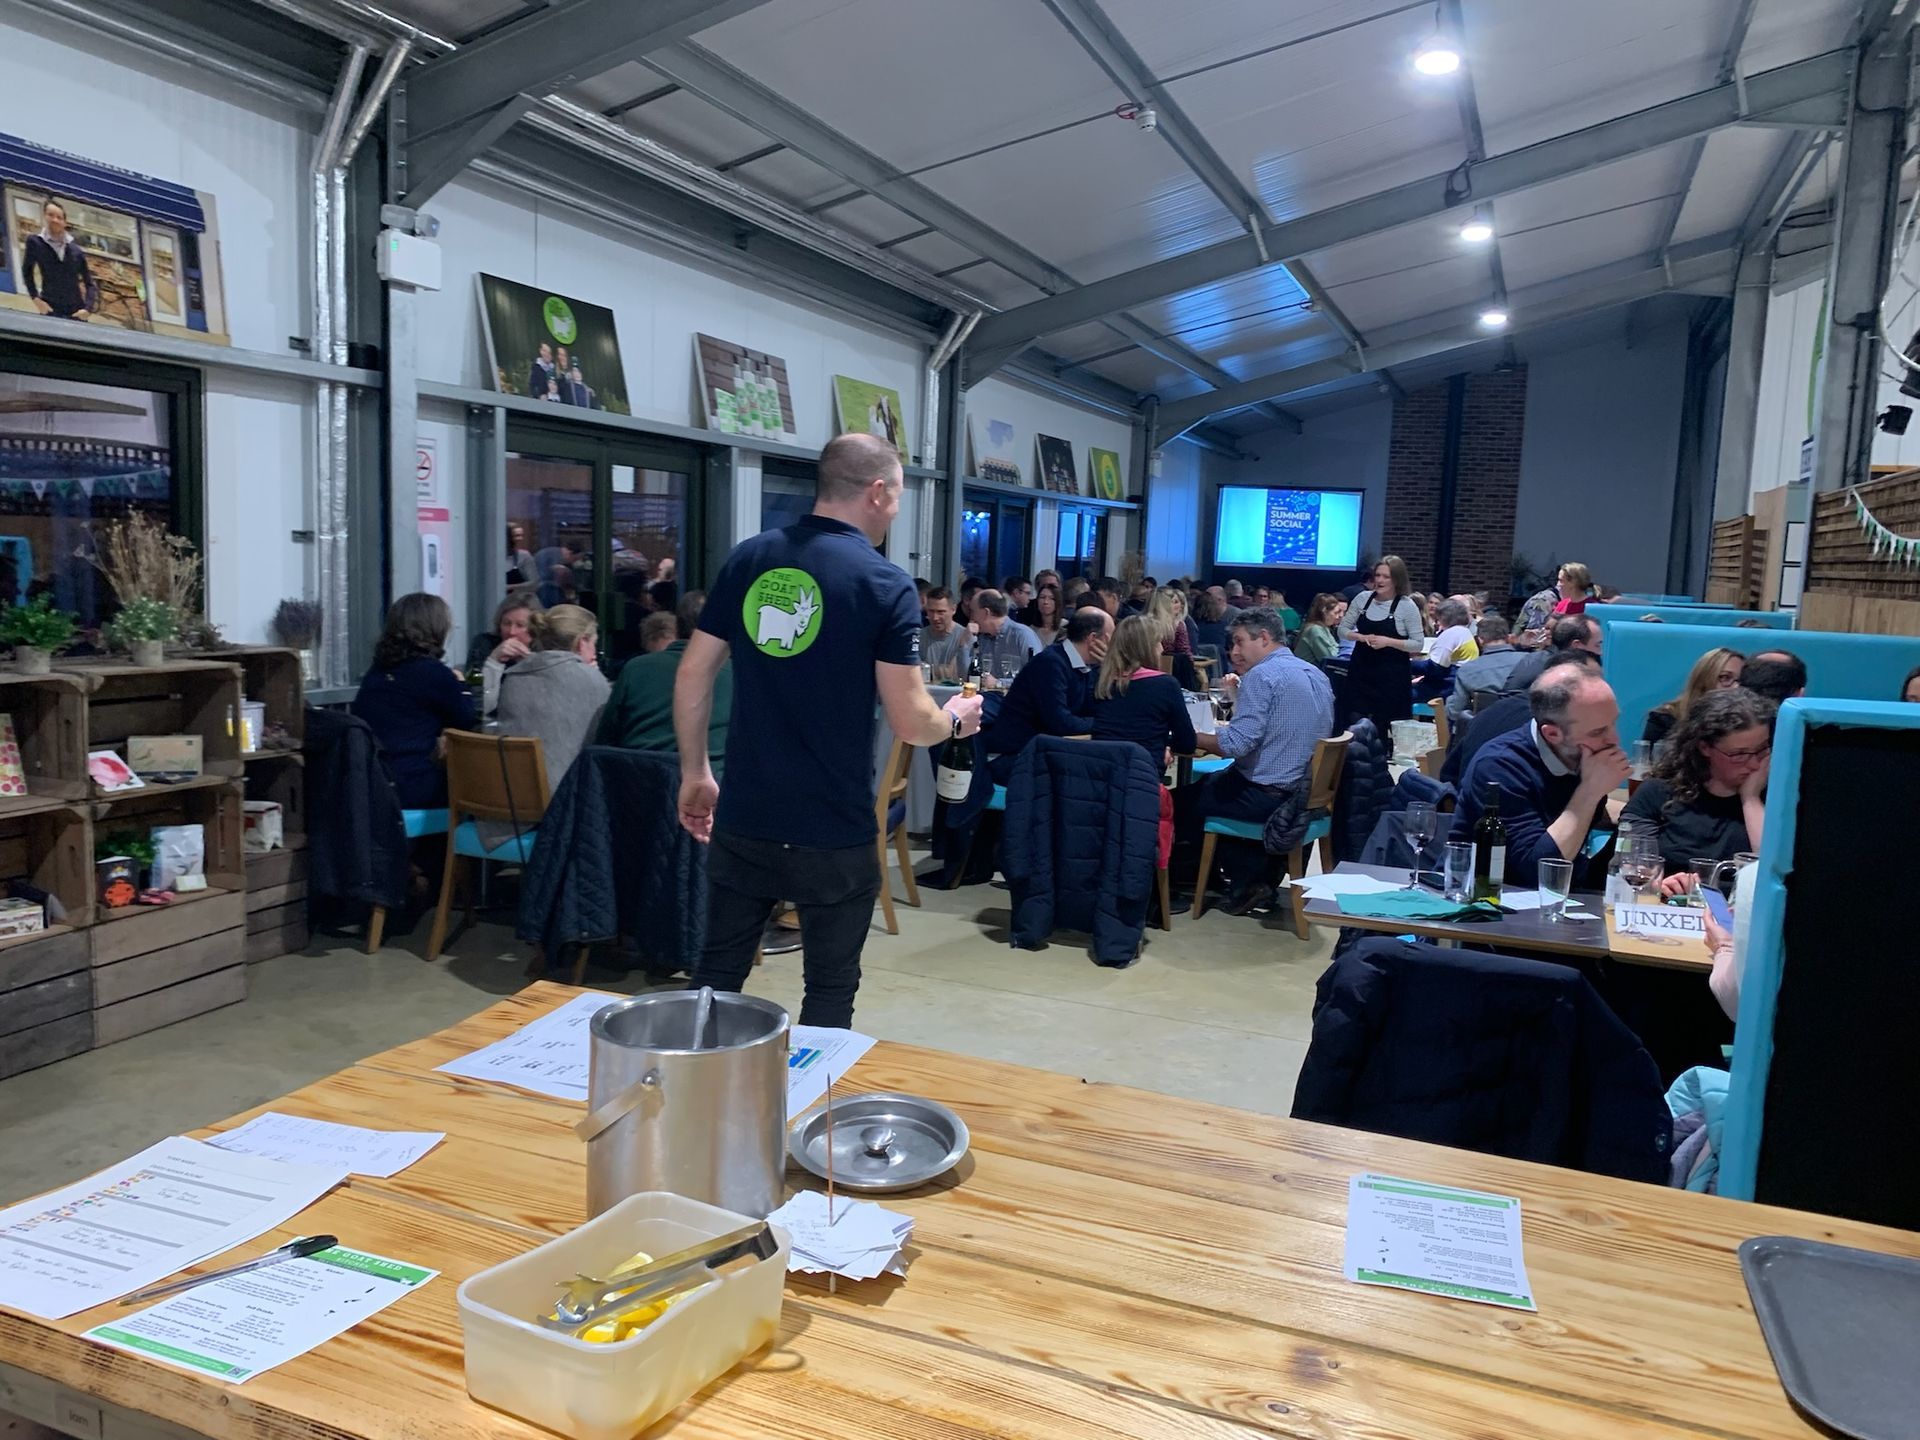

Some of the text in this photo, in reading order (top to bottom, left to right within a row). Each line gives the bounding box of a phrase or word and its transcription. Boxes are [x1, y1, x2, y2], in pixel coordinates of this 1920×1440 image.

[1270, 510, 1311, 521] SUMMER
[1270, 519, 1304, 529] SOCIAL
[772, 571, 793, 581] THE
[760, 579, 797, 594] GOAT
[758, 592, 791, 607] SHED
[342, 1252, 373, 1263] GOAT
[373, 1259, 403, 1271] SHED
